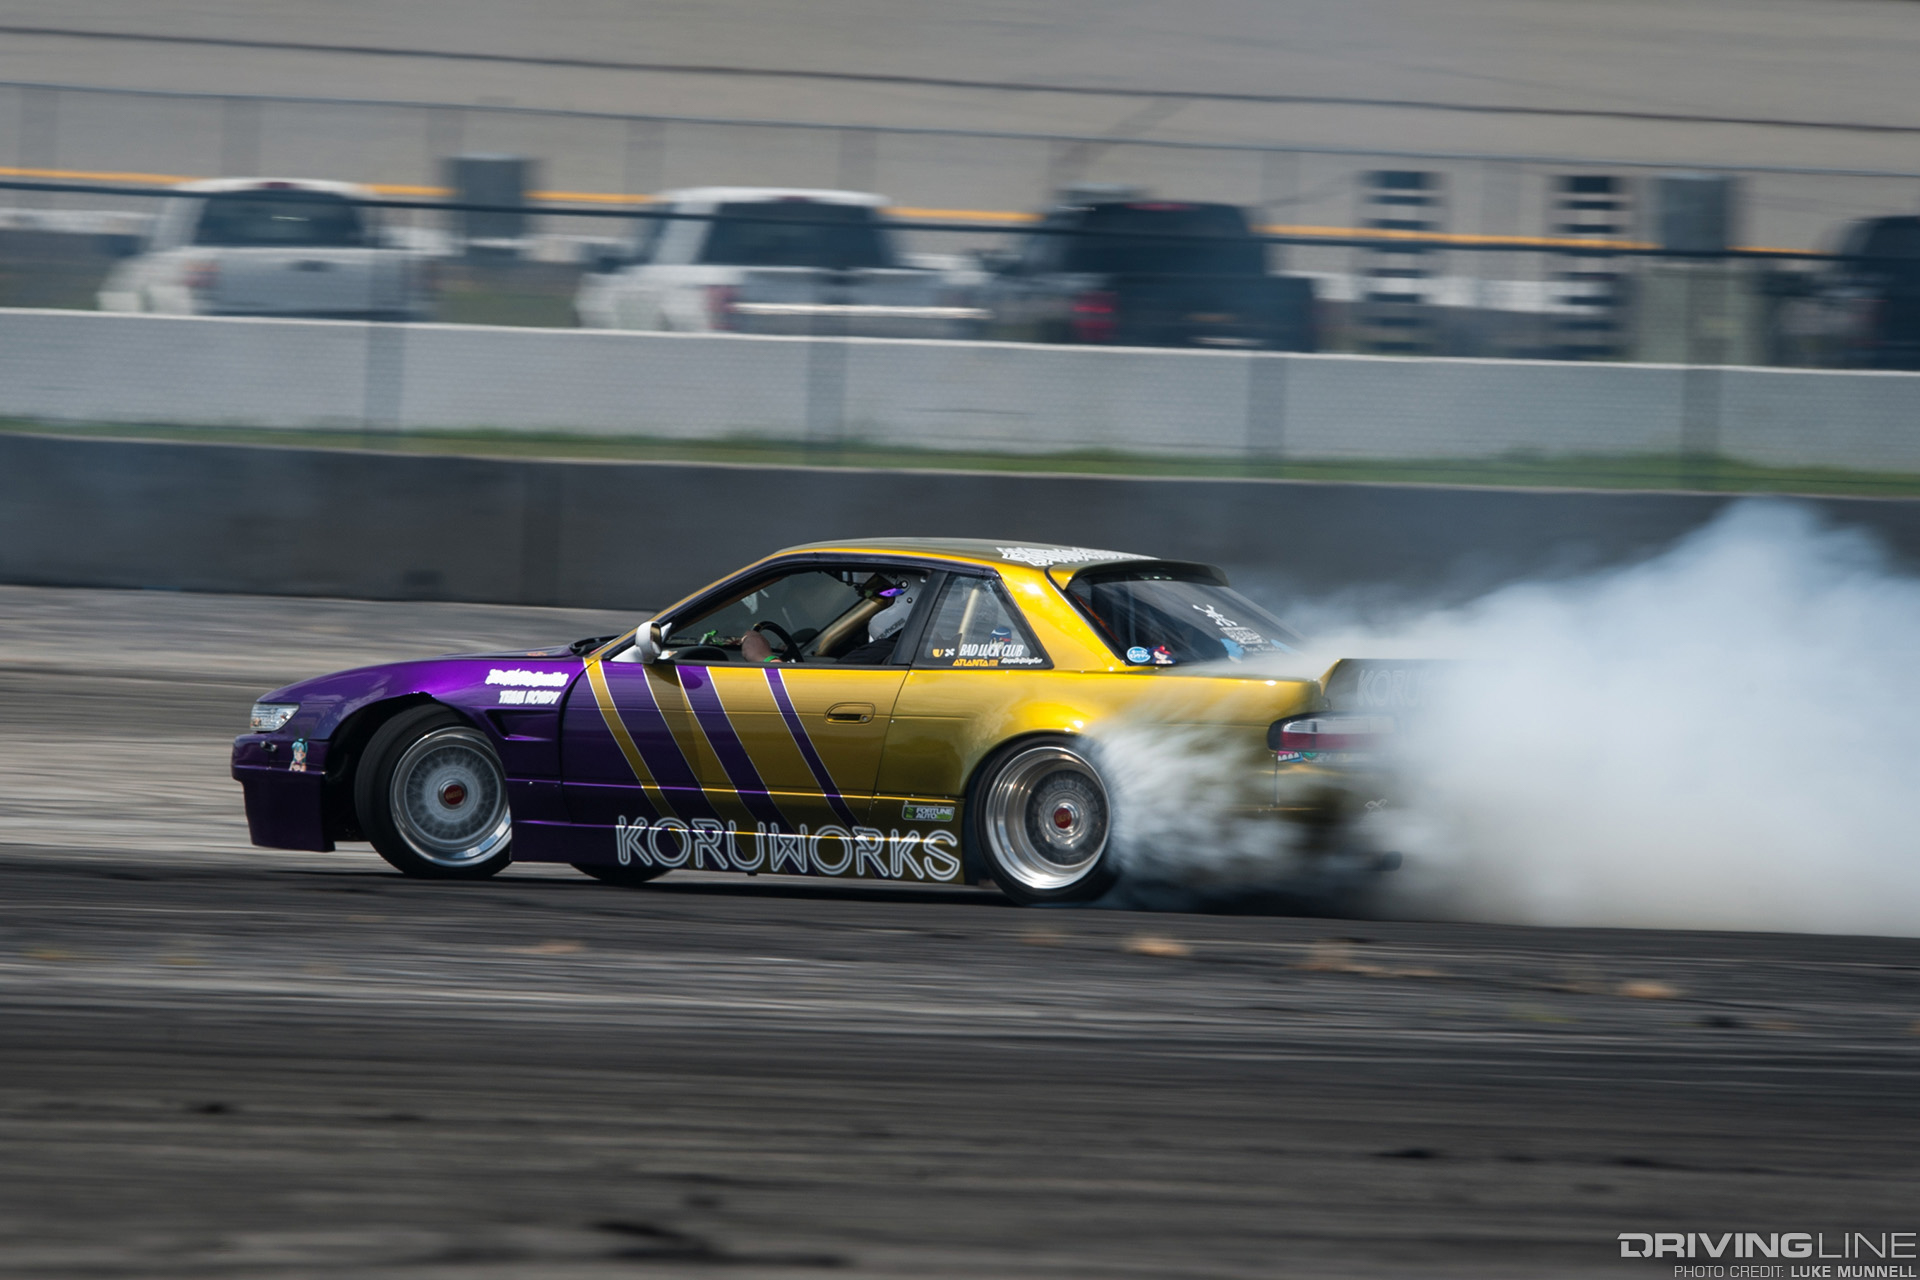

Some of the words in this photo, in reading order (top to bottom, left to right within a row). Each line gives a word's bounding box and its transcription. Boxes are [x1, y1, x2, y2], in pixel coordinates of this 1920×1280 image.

[959, 643, 978, 657] BAD
[978, 643, 1000, 658] LUCK
[1001, 643, 1024, 657] CLUB
[952, 658, 989, 667] ATLANTA
[916, 807, 954, 815] FORTUNE
[616, 815, 961, 881] KORUWORKS
